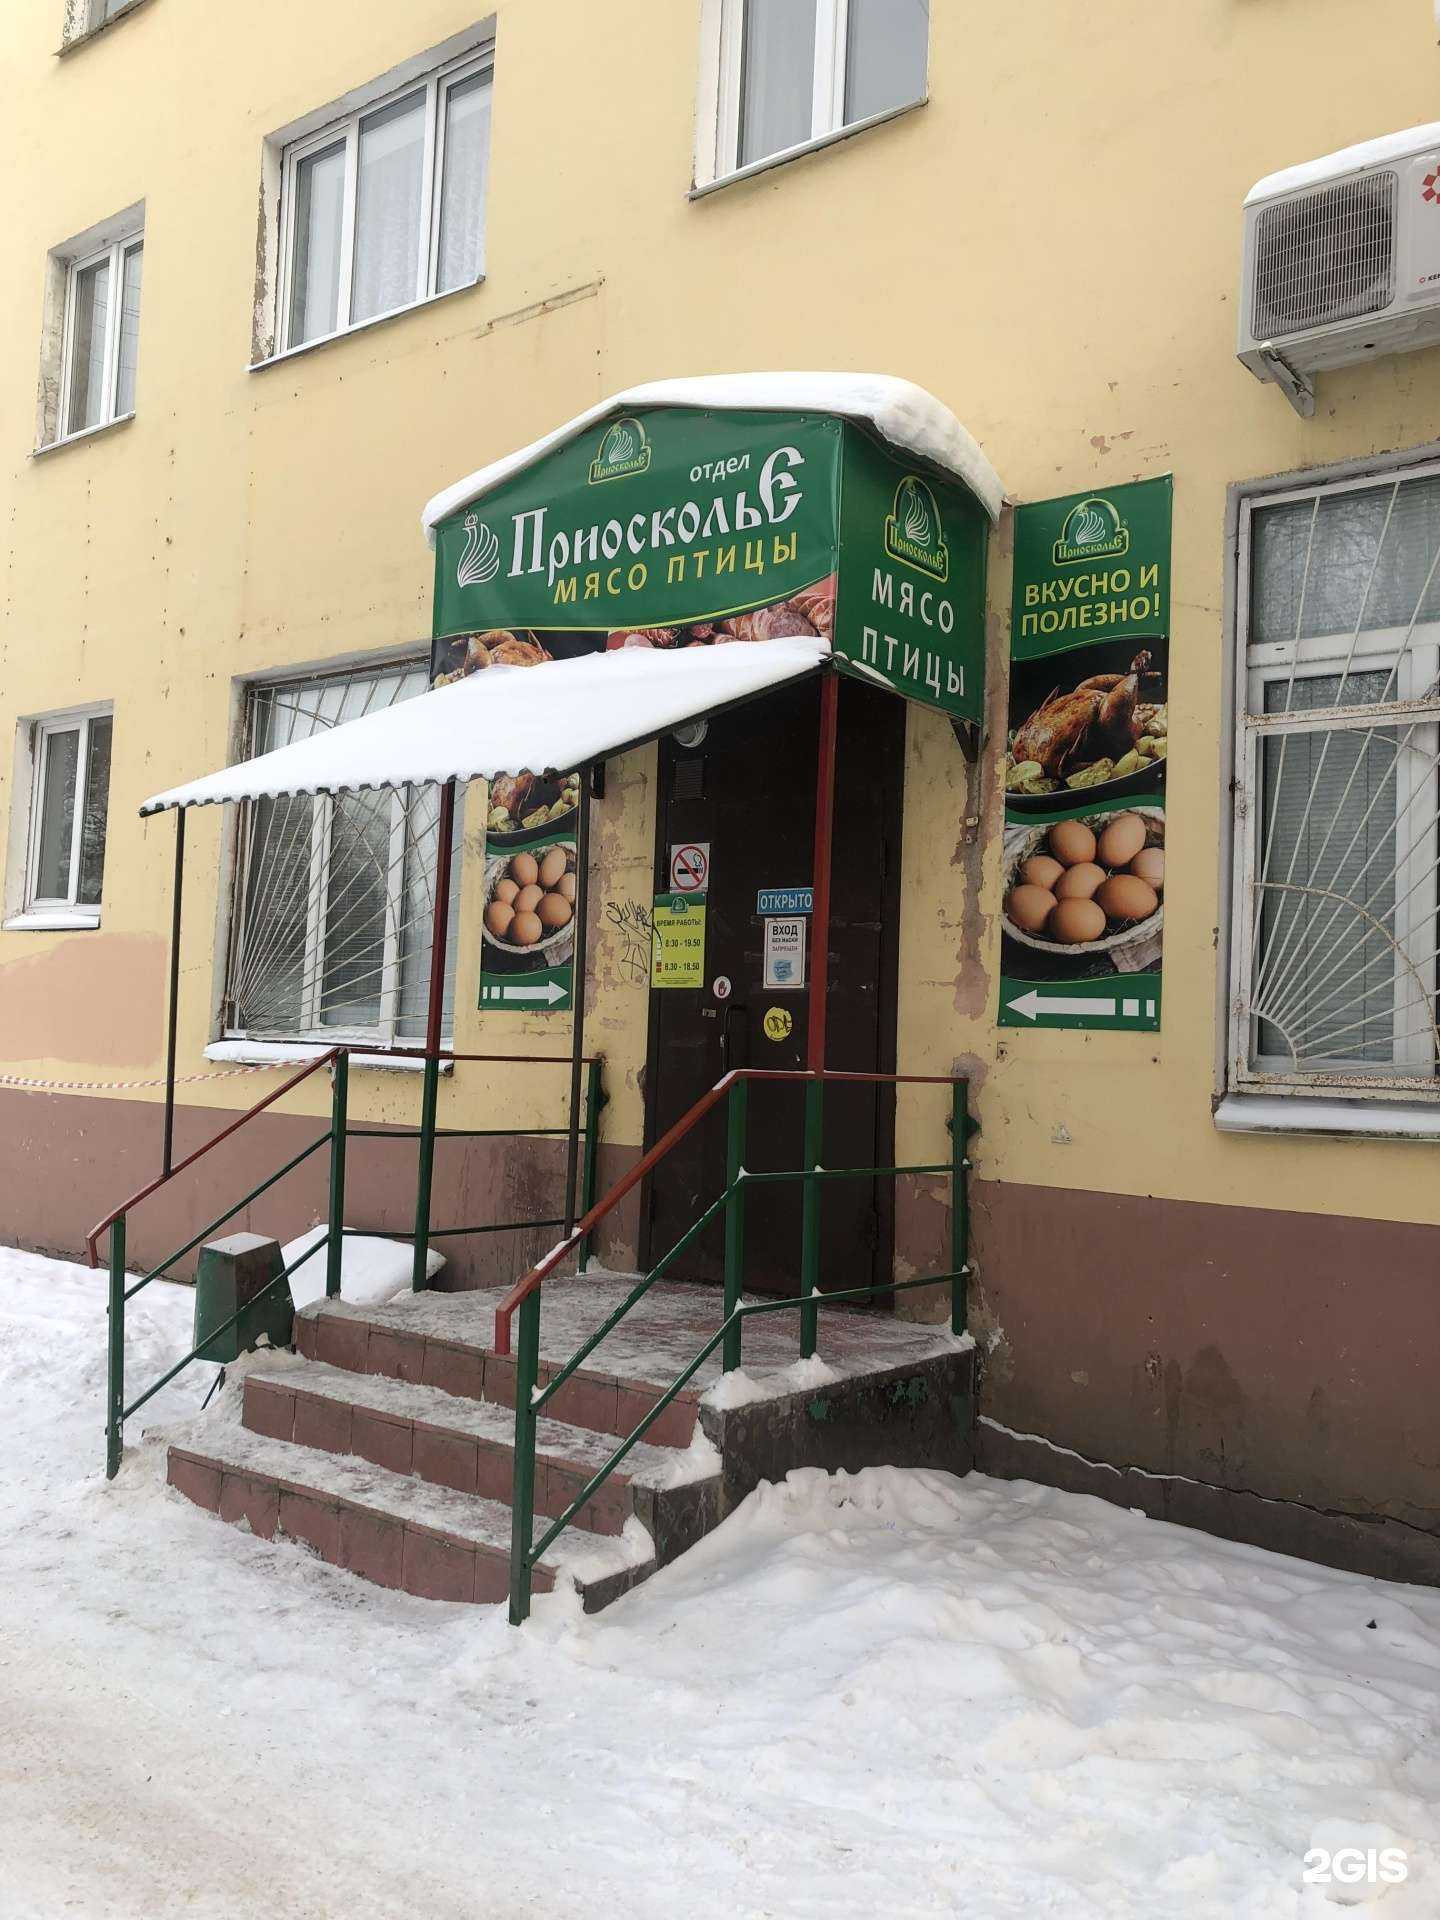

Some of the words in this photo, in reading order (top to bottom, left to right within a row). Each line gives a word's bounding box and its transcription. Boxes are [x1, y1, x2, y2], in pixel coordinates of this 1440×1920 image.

[690, 453, 751, 483] отдел
[553, 562, 648, 605] МЯСО
[667, 532, 798, 584] ПТИЦЫ
[1025, 568, 1131, 607] ВКУСНО
[1140, 563, 1160, 589] И
[872, 567, 955, 635] МЯСО
[1021, 593, 1161, 637] ПОЛЕЗНО!
[862, 626, 965, 698] ПТИЦЫ
[760, 893, 813, 910] ОТКРЫТО
[772, 925, 798, 937] ВХОД
